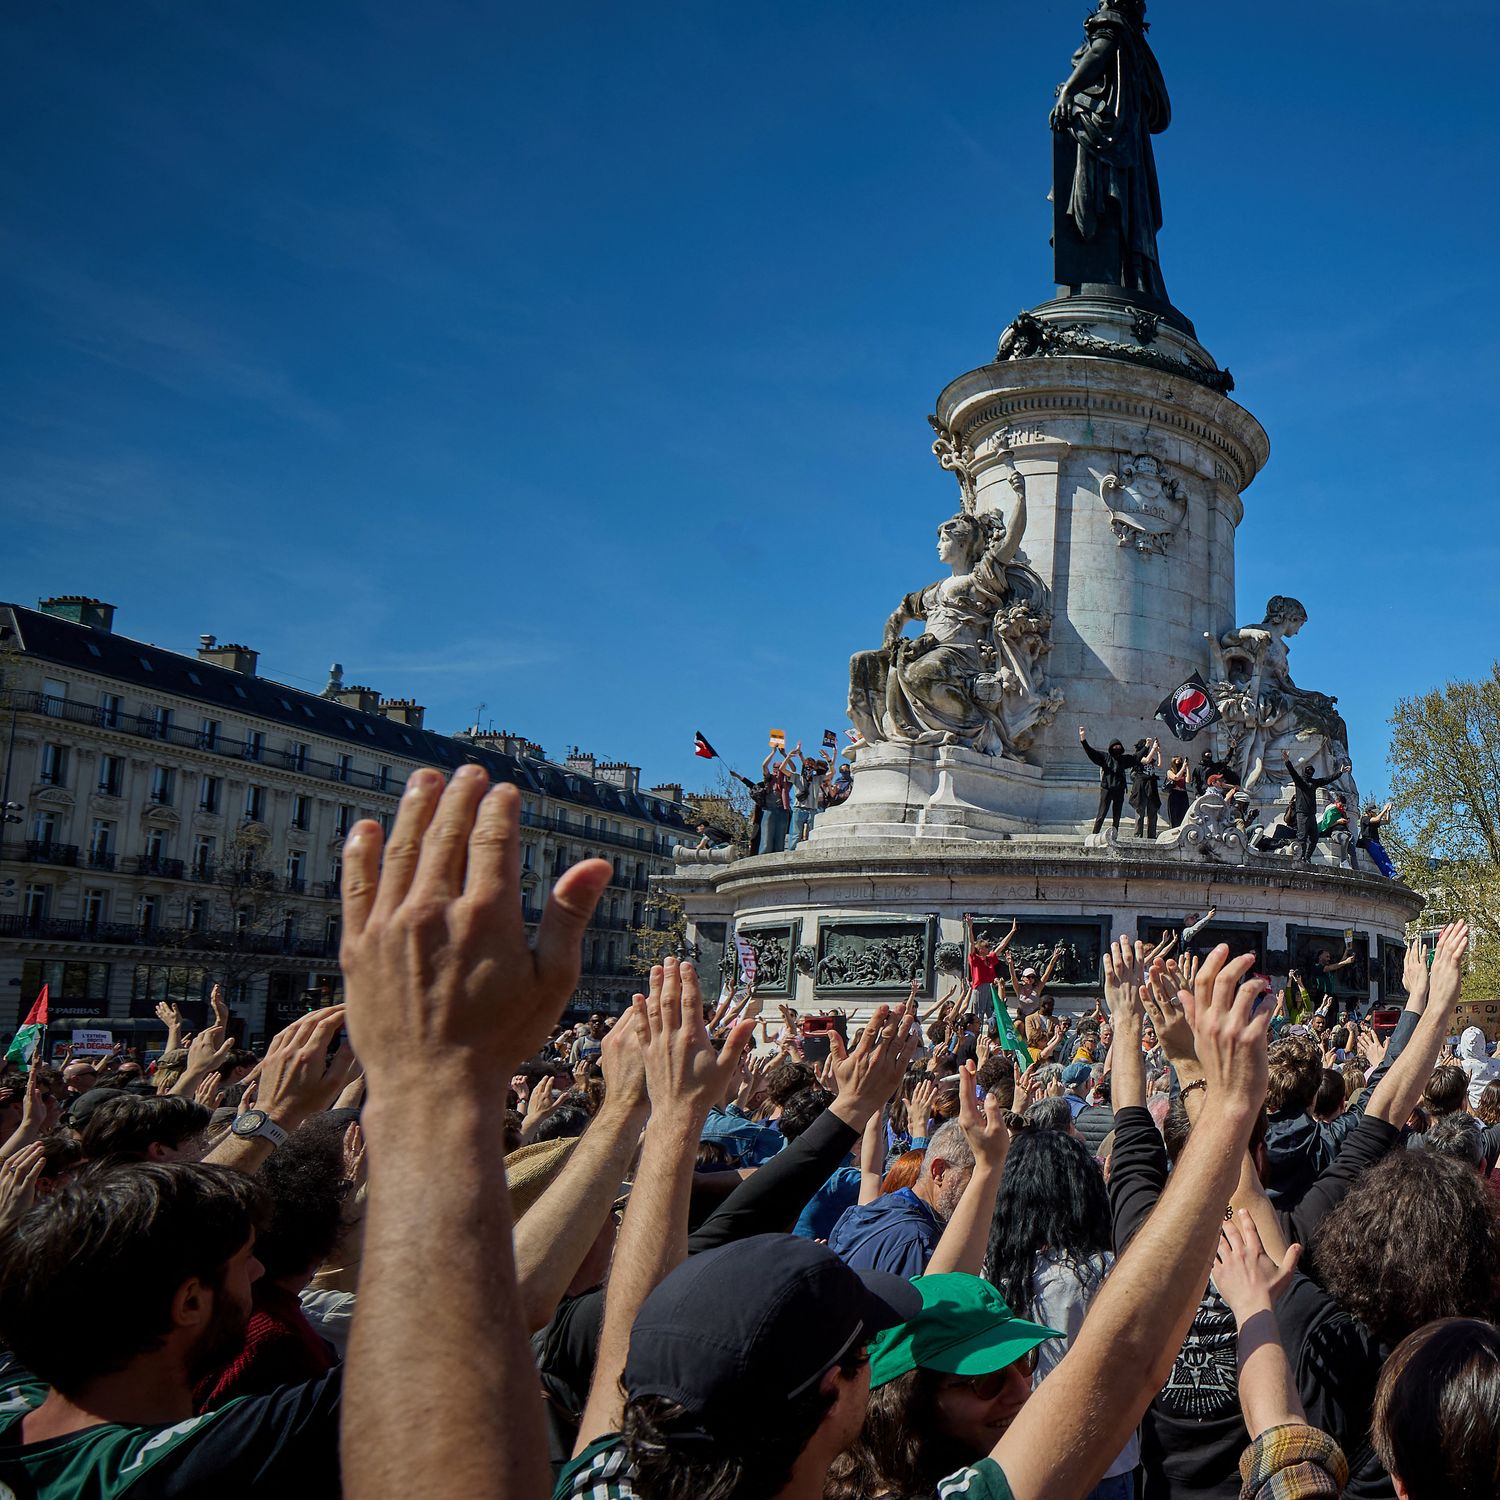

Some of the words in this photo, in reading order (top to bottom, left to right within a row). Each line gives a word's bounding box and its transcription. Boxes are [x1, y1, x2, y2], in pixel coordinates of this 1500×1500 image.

[844, 887, 888, 899] JUILLET
[991, 887, 999, 898] 4
[1228, 895, 1254, 905] 1790
[55, 1007, 101, 1015] PARIBAS
